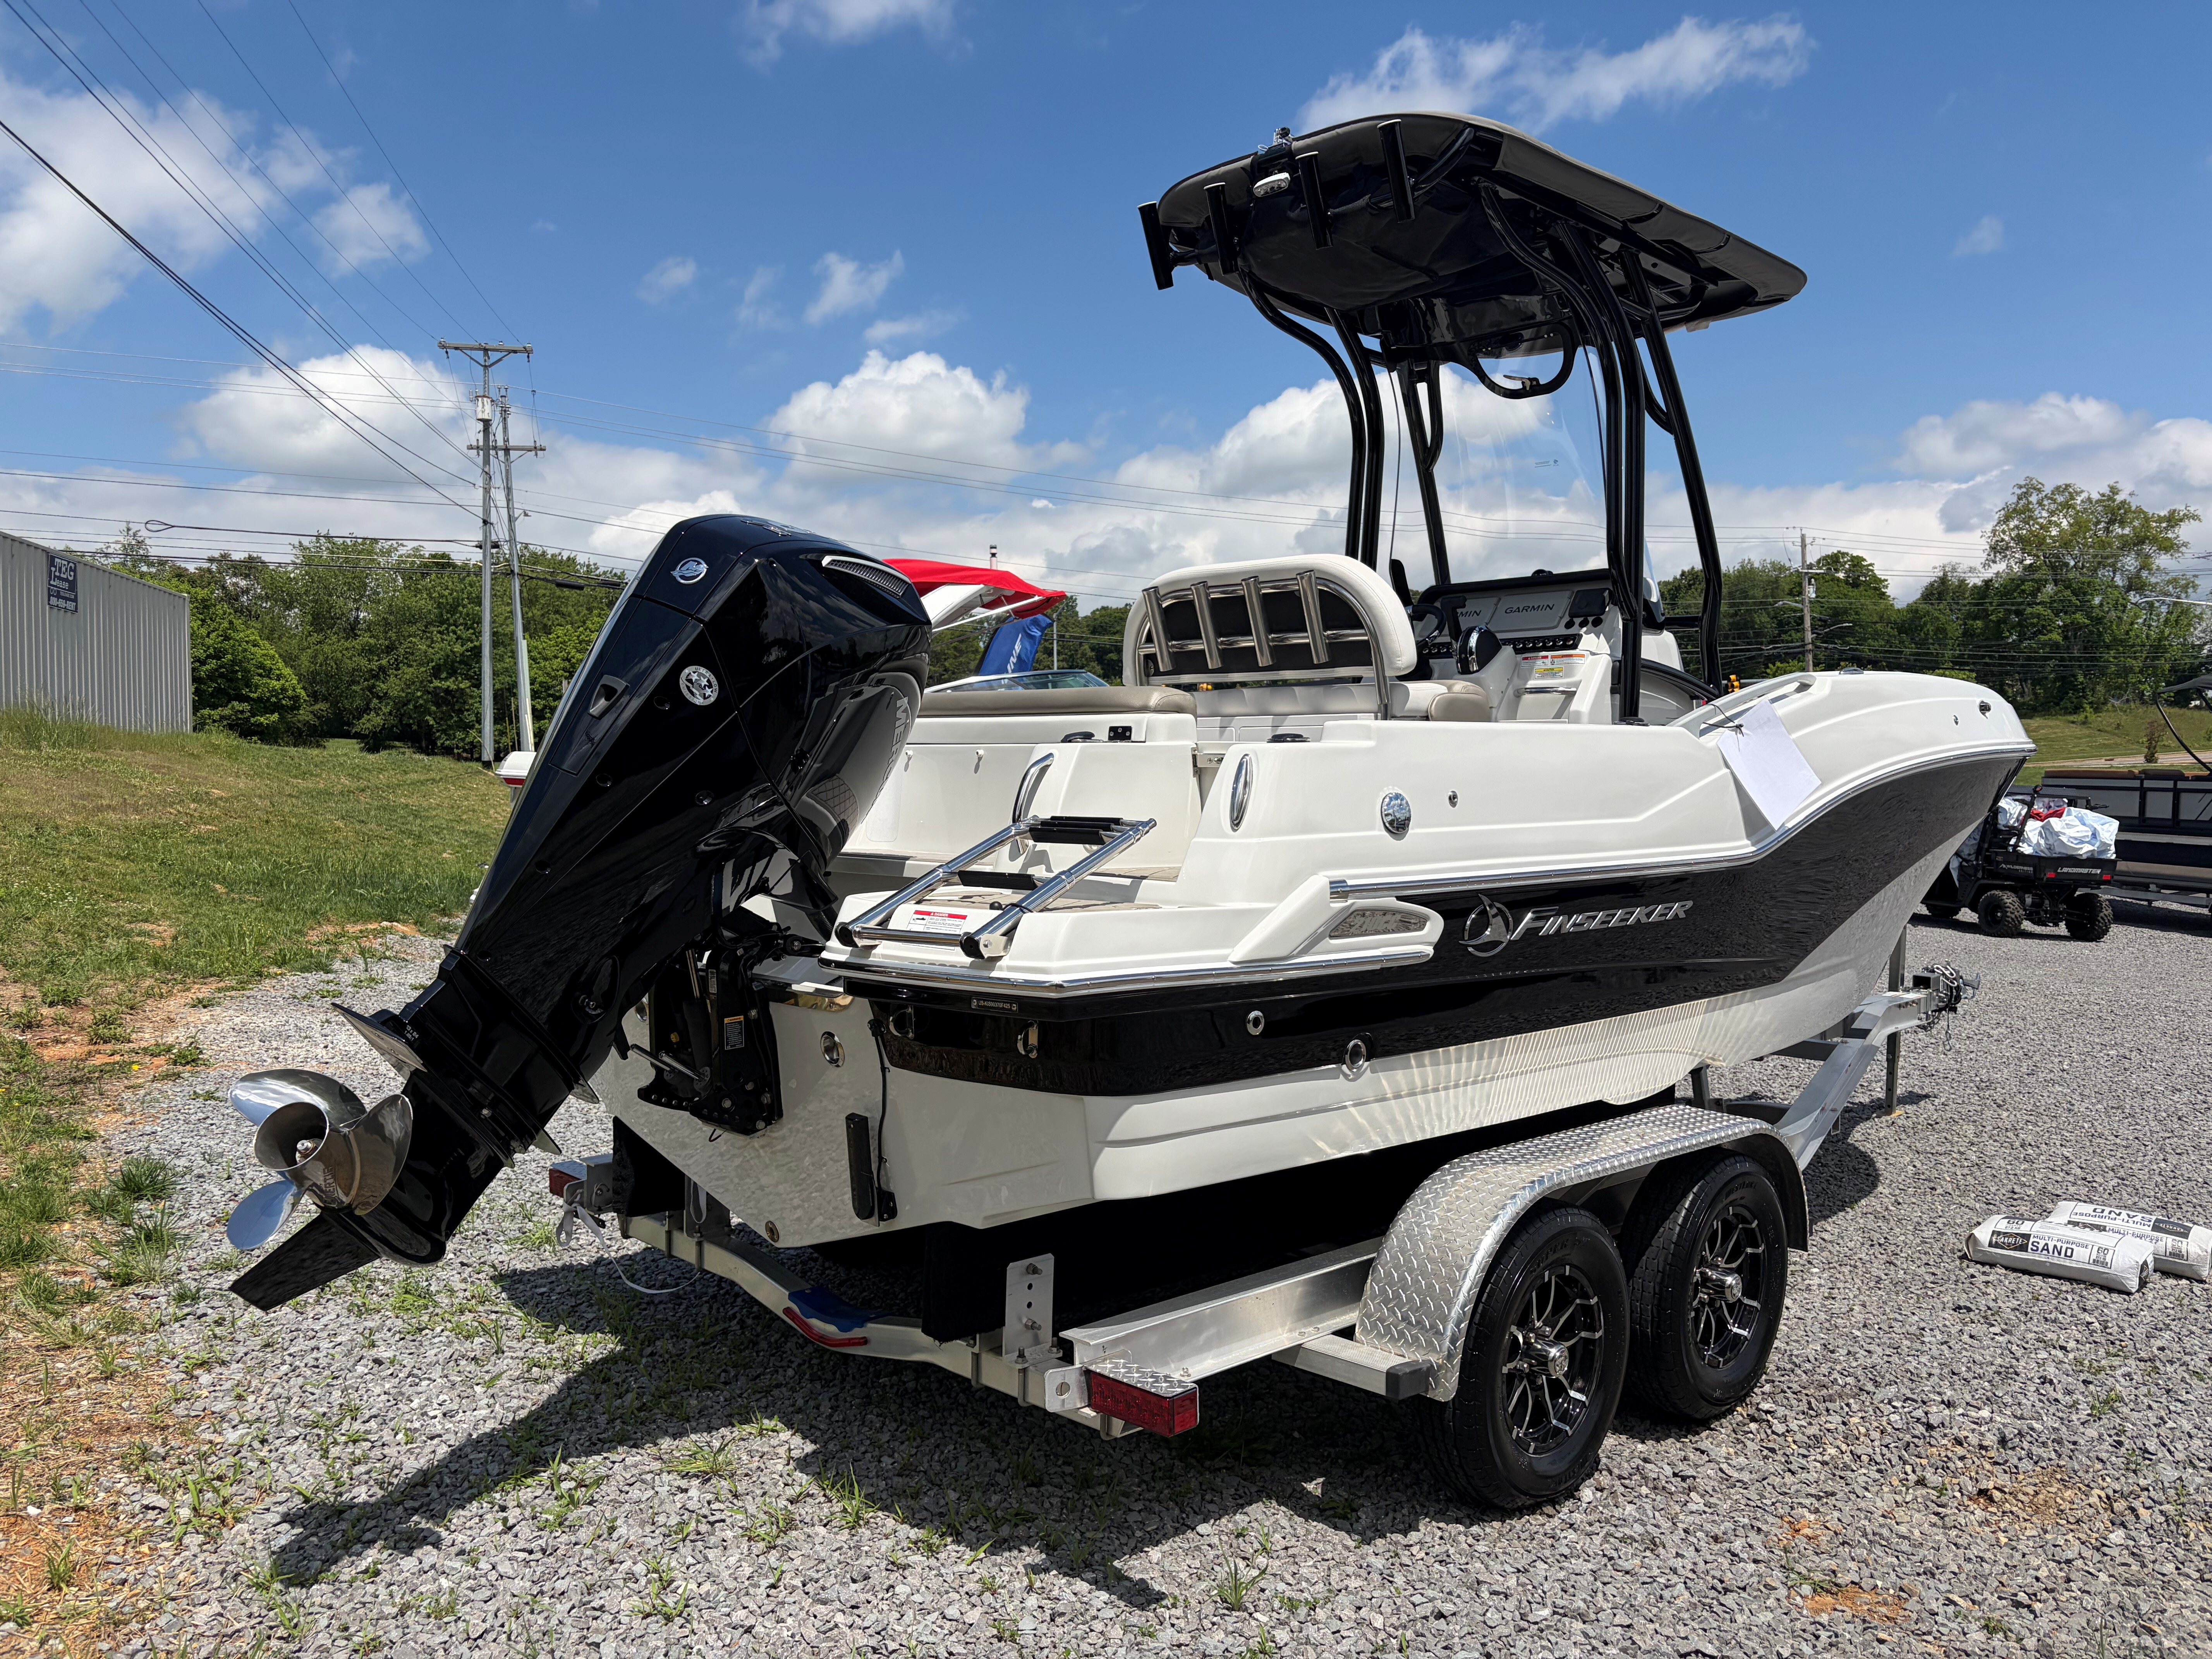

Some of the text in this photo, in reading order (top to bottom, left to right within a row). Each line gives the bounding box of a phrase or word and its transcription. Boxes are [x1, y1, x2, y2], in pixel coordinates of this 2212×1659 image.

[55, 558, 74, 580] TEG
[50, 567, 69, 589] Lease
[1504, 604, 1555, 614] GARMIN
[695, 667, 711, 678] ULTRA
[1510, 900, 1693, 940] FINSEEKER
[2072, 1212, 2151, 1228] MULTI-PURPOSE
[2092, 1207, 2154, 1223] SAND
[1996, 1235, 2023, 1244] SAKRETE
[2032, 1235, 2089, 1249] MULTI-PURPOSE
[2108, 1227, 2164, 1242] MULTI-PURPOSE
[2030, 1241, 2075, 1259] SAND
[2097, 1247, 2109, 1255] 60
